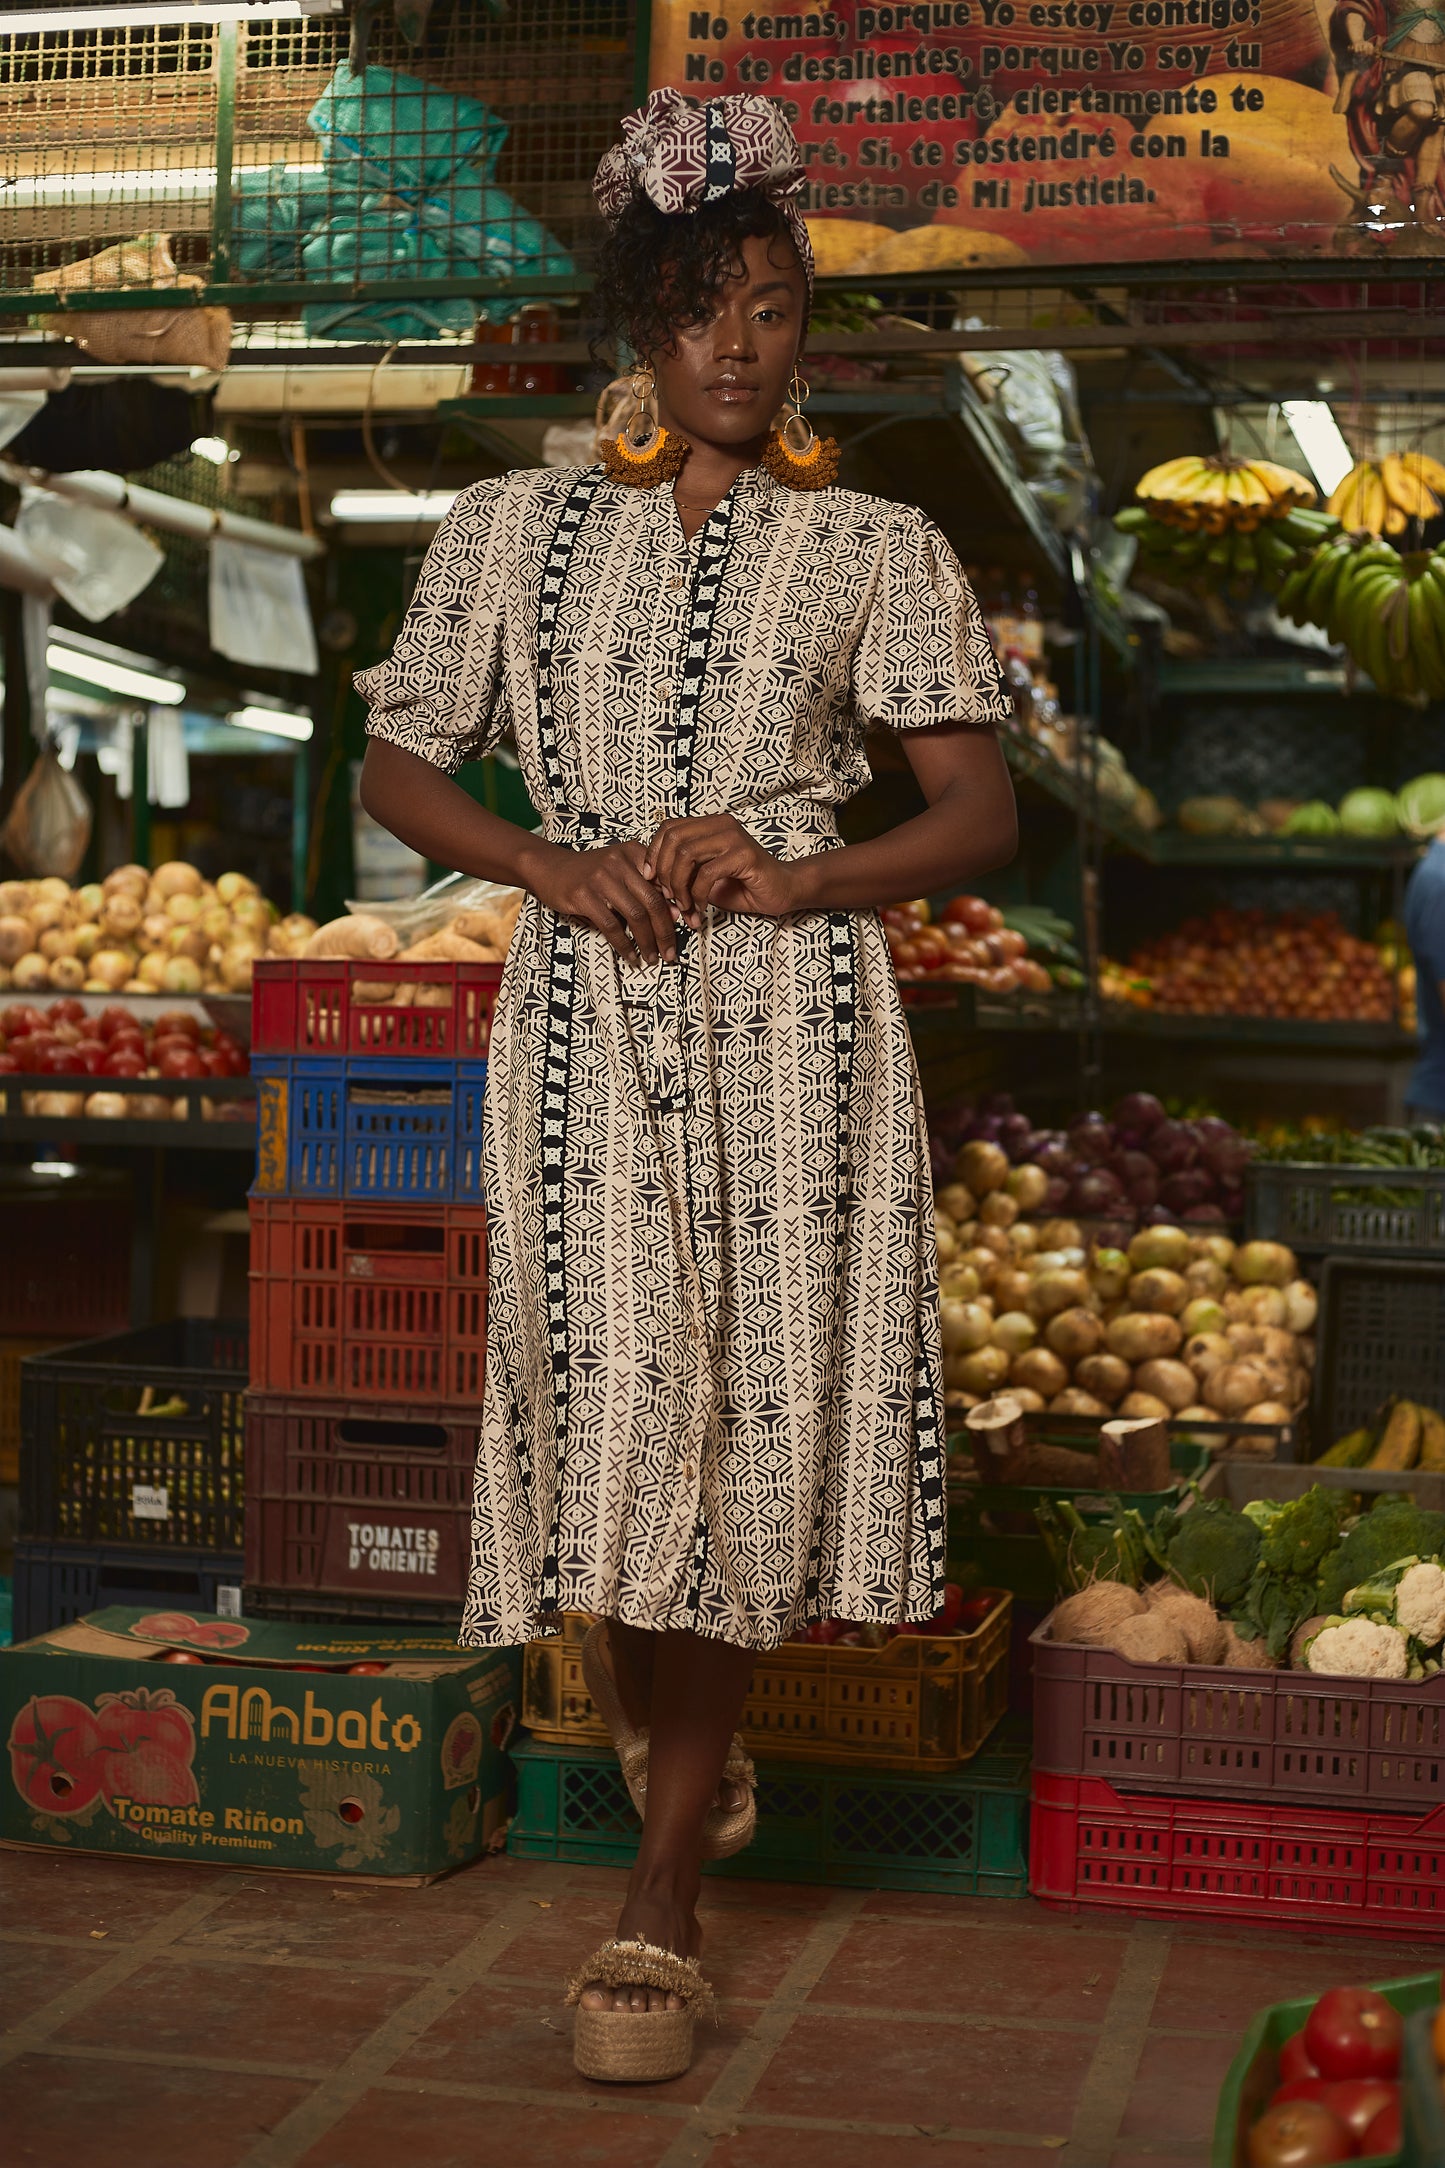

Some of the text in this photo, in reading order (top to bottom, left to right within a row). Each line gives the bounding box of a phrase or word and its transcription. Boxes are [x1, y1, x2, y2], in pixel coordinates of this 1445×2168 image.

[689, 0, 1261, 41] No temas, porque Yo estoy contigo;
[685, 37, 1262, 83] No te desalientes, porque Yo soy tu
[811, 86, 1001, 124] fortaleceré,
[1014, 83, 1218, 116] ciertamente
[1230, 83, 1265, 112] te
[859, 138, 900, 170] Sí,
[910, 138, 944, 166] te
[953, 128, 1116, 166] sostendré
[1129, 132, 1187, 158] con
[1201, 129, 1230, 158] la
[918, 180, 958, 209] de
[972, 178, 1010, 209] Mi
[1023, 173, 1156, 213] justicia.
[347, 1523, 439, 1553] TOMATES
[229, 1752, 392, 1775] LA NUEVA HISTORIA
[112, 1798, 304, 1835] Tomate Riñon
[141, 1827, 274, 1850] Quality Premium
